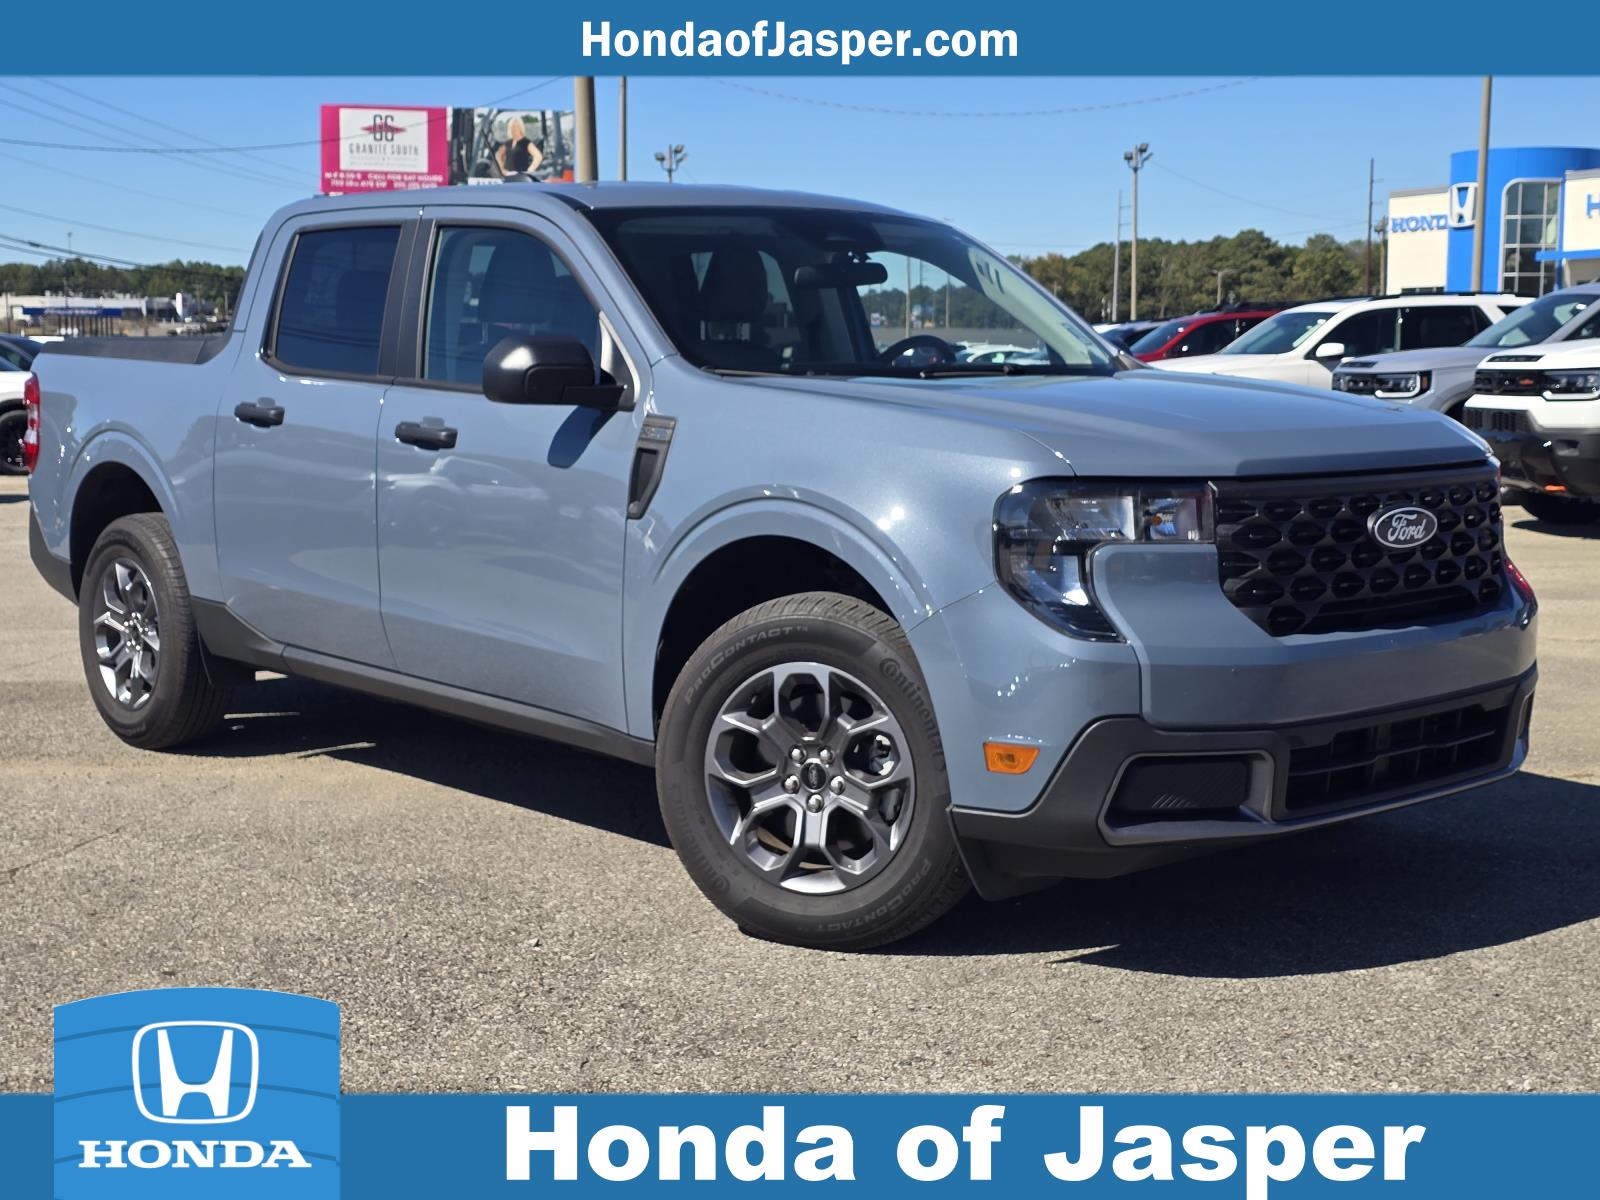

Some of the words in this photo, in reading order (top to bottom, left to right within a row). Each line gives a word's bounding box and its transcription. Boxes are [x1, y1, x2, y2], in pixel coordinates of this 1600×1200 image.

[348, 143, 388, 155] GRANITE
[391, 144, 419, 156] SOUTH
[1391, 214, 1448, 232] HOND
[1387, 513, 1427, 542] Ford
